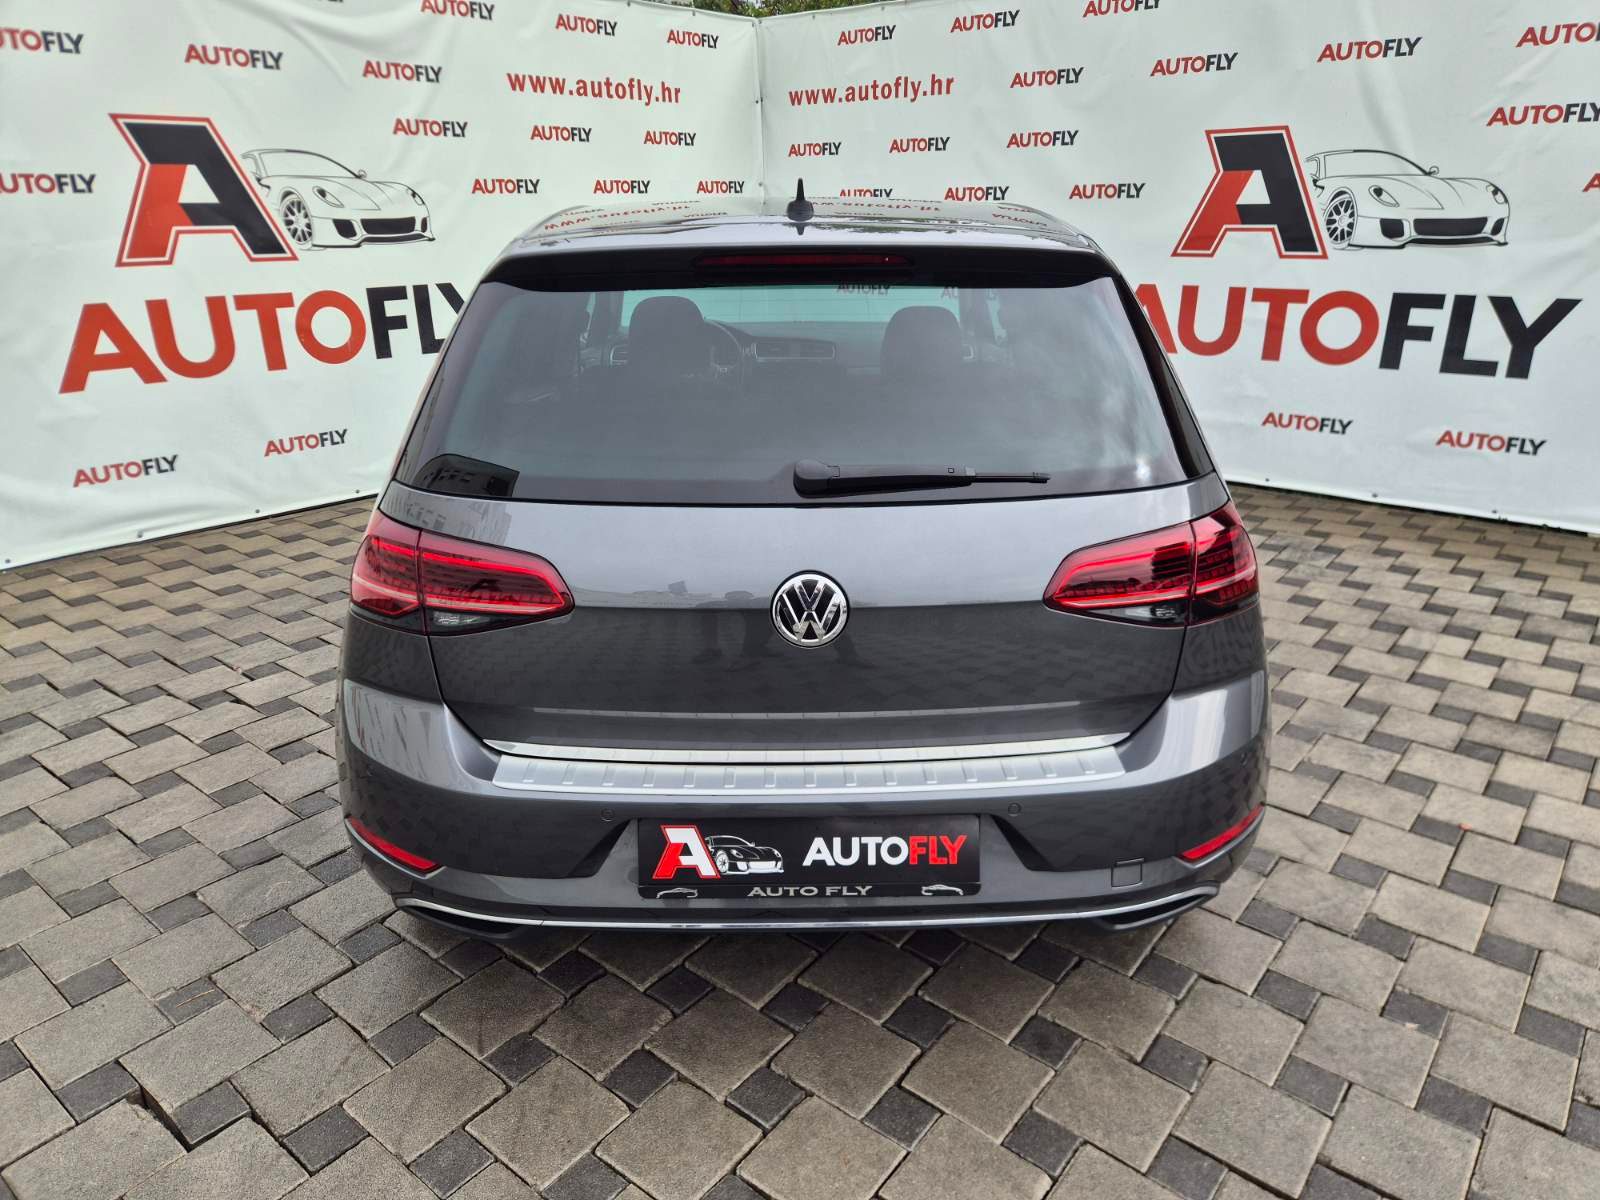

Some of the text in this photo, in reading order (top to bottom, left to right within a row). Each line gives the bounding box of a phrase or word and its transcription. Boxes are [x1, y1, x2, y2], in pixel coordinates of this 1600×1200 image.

[421, 0, 494, 20] AUTOFLY
[556, 14, 617, 36] AUTOFLY
[951, 10, 1020, 33] AUTOFLY
[667, 30, 719, 48] AUTOFLY
[838, 25, 896, 46] AUTOFLY
[1516, 23, 1600, 47] AUTO
[185, 44, 283, 70] AUTOFLY
[1317, 37, 1422, 62] AUTOFLY
[363, 60, 442, 83] AUTOFLY
[1150, 52, 1238, 76] AUTOFLY
[1010, 67, 1084, 88] AUTOFLY
[507, 73, 680, 106] www.autofly.hr
[789, 74, 954, 106] www.autofly.hr
[393, 119, 468, 137] AUTOFLY
[530, 125, 592, 142] AUTOFLY
[644, 131, 696, 146] AUTOFLY
[789, 142, 841, 157] AUTOFLY
[889, 137, 950, 153] AUTOFLY
[1007, 130, 1078, 148] AUTOFLY
[0, 173, 96, 193] UTOFLY
[472, 179, 540, 194] AUTOFLY
[593, 180, 650, 194] AUTOFLY
[697, 181, 744, 193] AUTOFLY
[945, 186, 1009, 200] AUTOFLY
[1069, 183, 1145, 199] AUTOFLY
[1262, 412, 1353, 435] AUTOFLY
[265, 429, 347, 456] AUTOFLY
[1436, 431, 1546, 456] AUTOFLY
[74, 455, 178, 487] AUTOFLY
[802, 834, 968, 866] AUTOFLY
[747, 885, 873, 897] AUTO FLY
